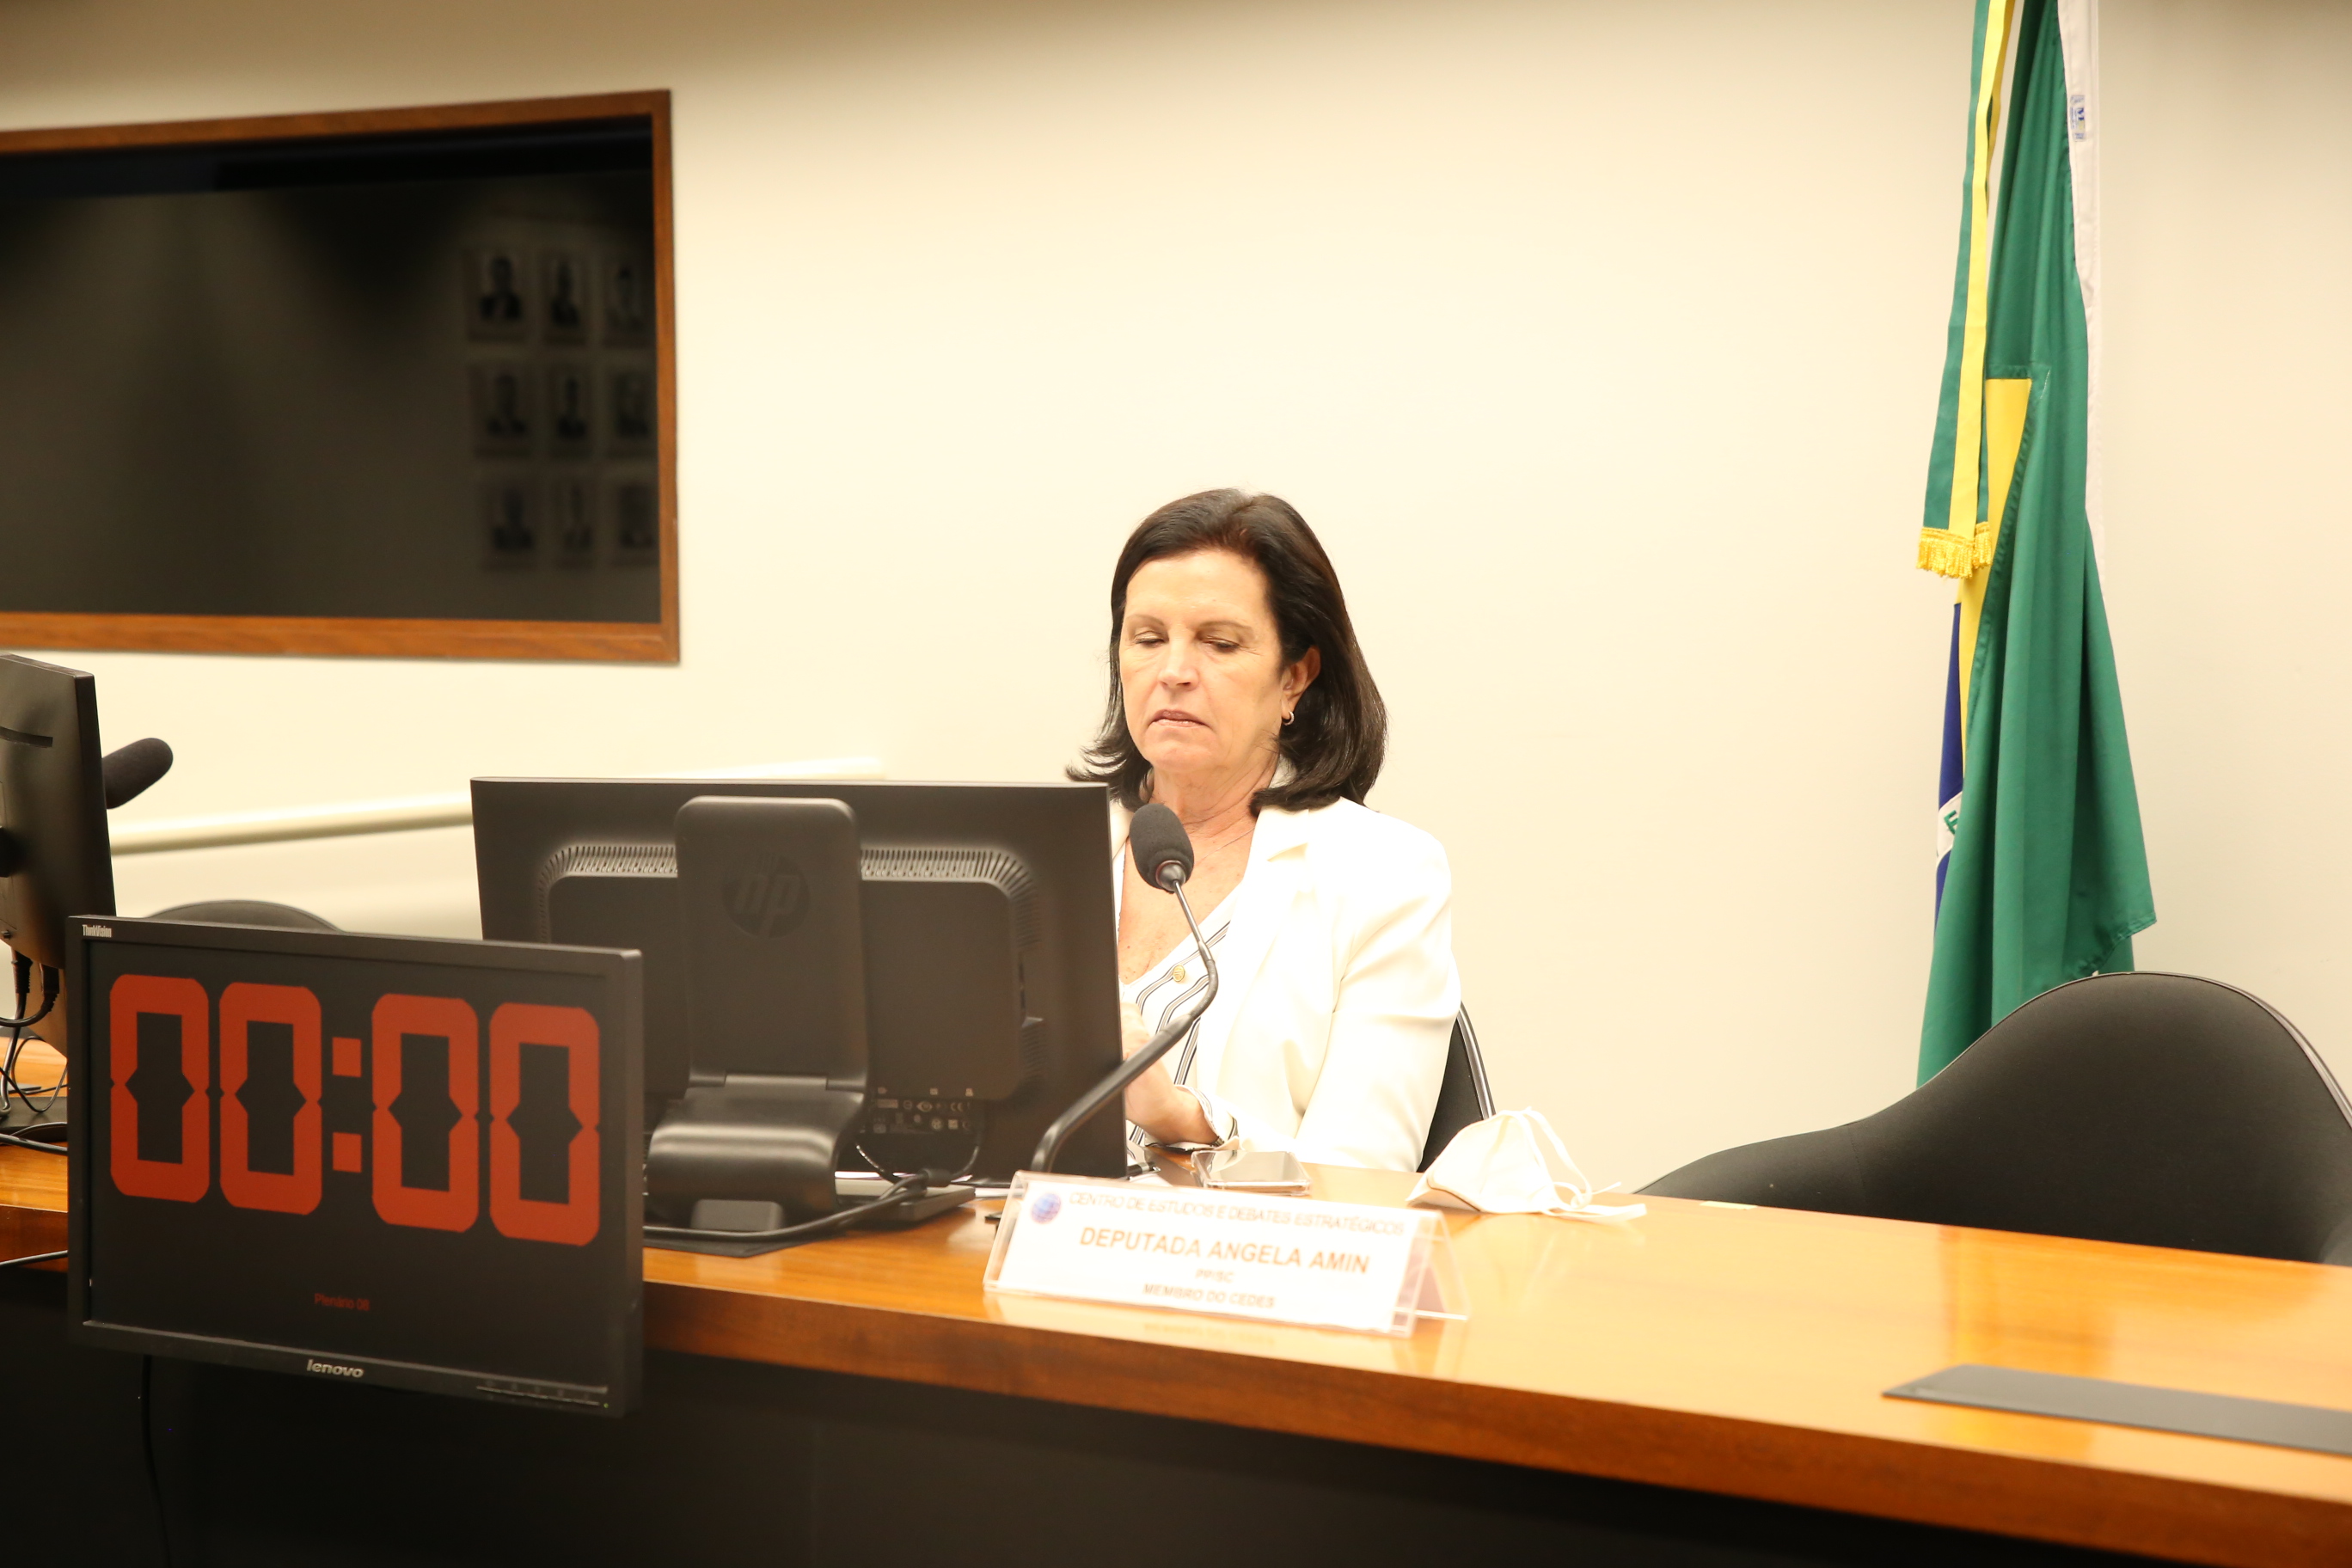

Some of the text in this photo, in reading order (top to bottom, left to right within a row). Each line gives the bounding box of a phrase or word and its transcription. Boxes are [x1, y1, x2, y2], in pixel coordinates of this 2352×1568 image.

[110, 974, 600, 1246] 00:00
[1069, 1191, 1406, 1236] CENTRO DE ESTUDOS E DEBATES ESTRATÉGICOS
[1080, 1227, 1370, 1274] DEPUTADA ANGELA AMIN
[1142, 1283, 1276, 1308] MEMBRO DO CEDES
[307, 1359, 364, 1378] lenovo
